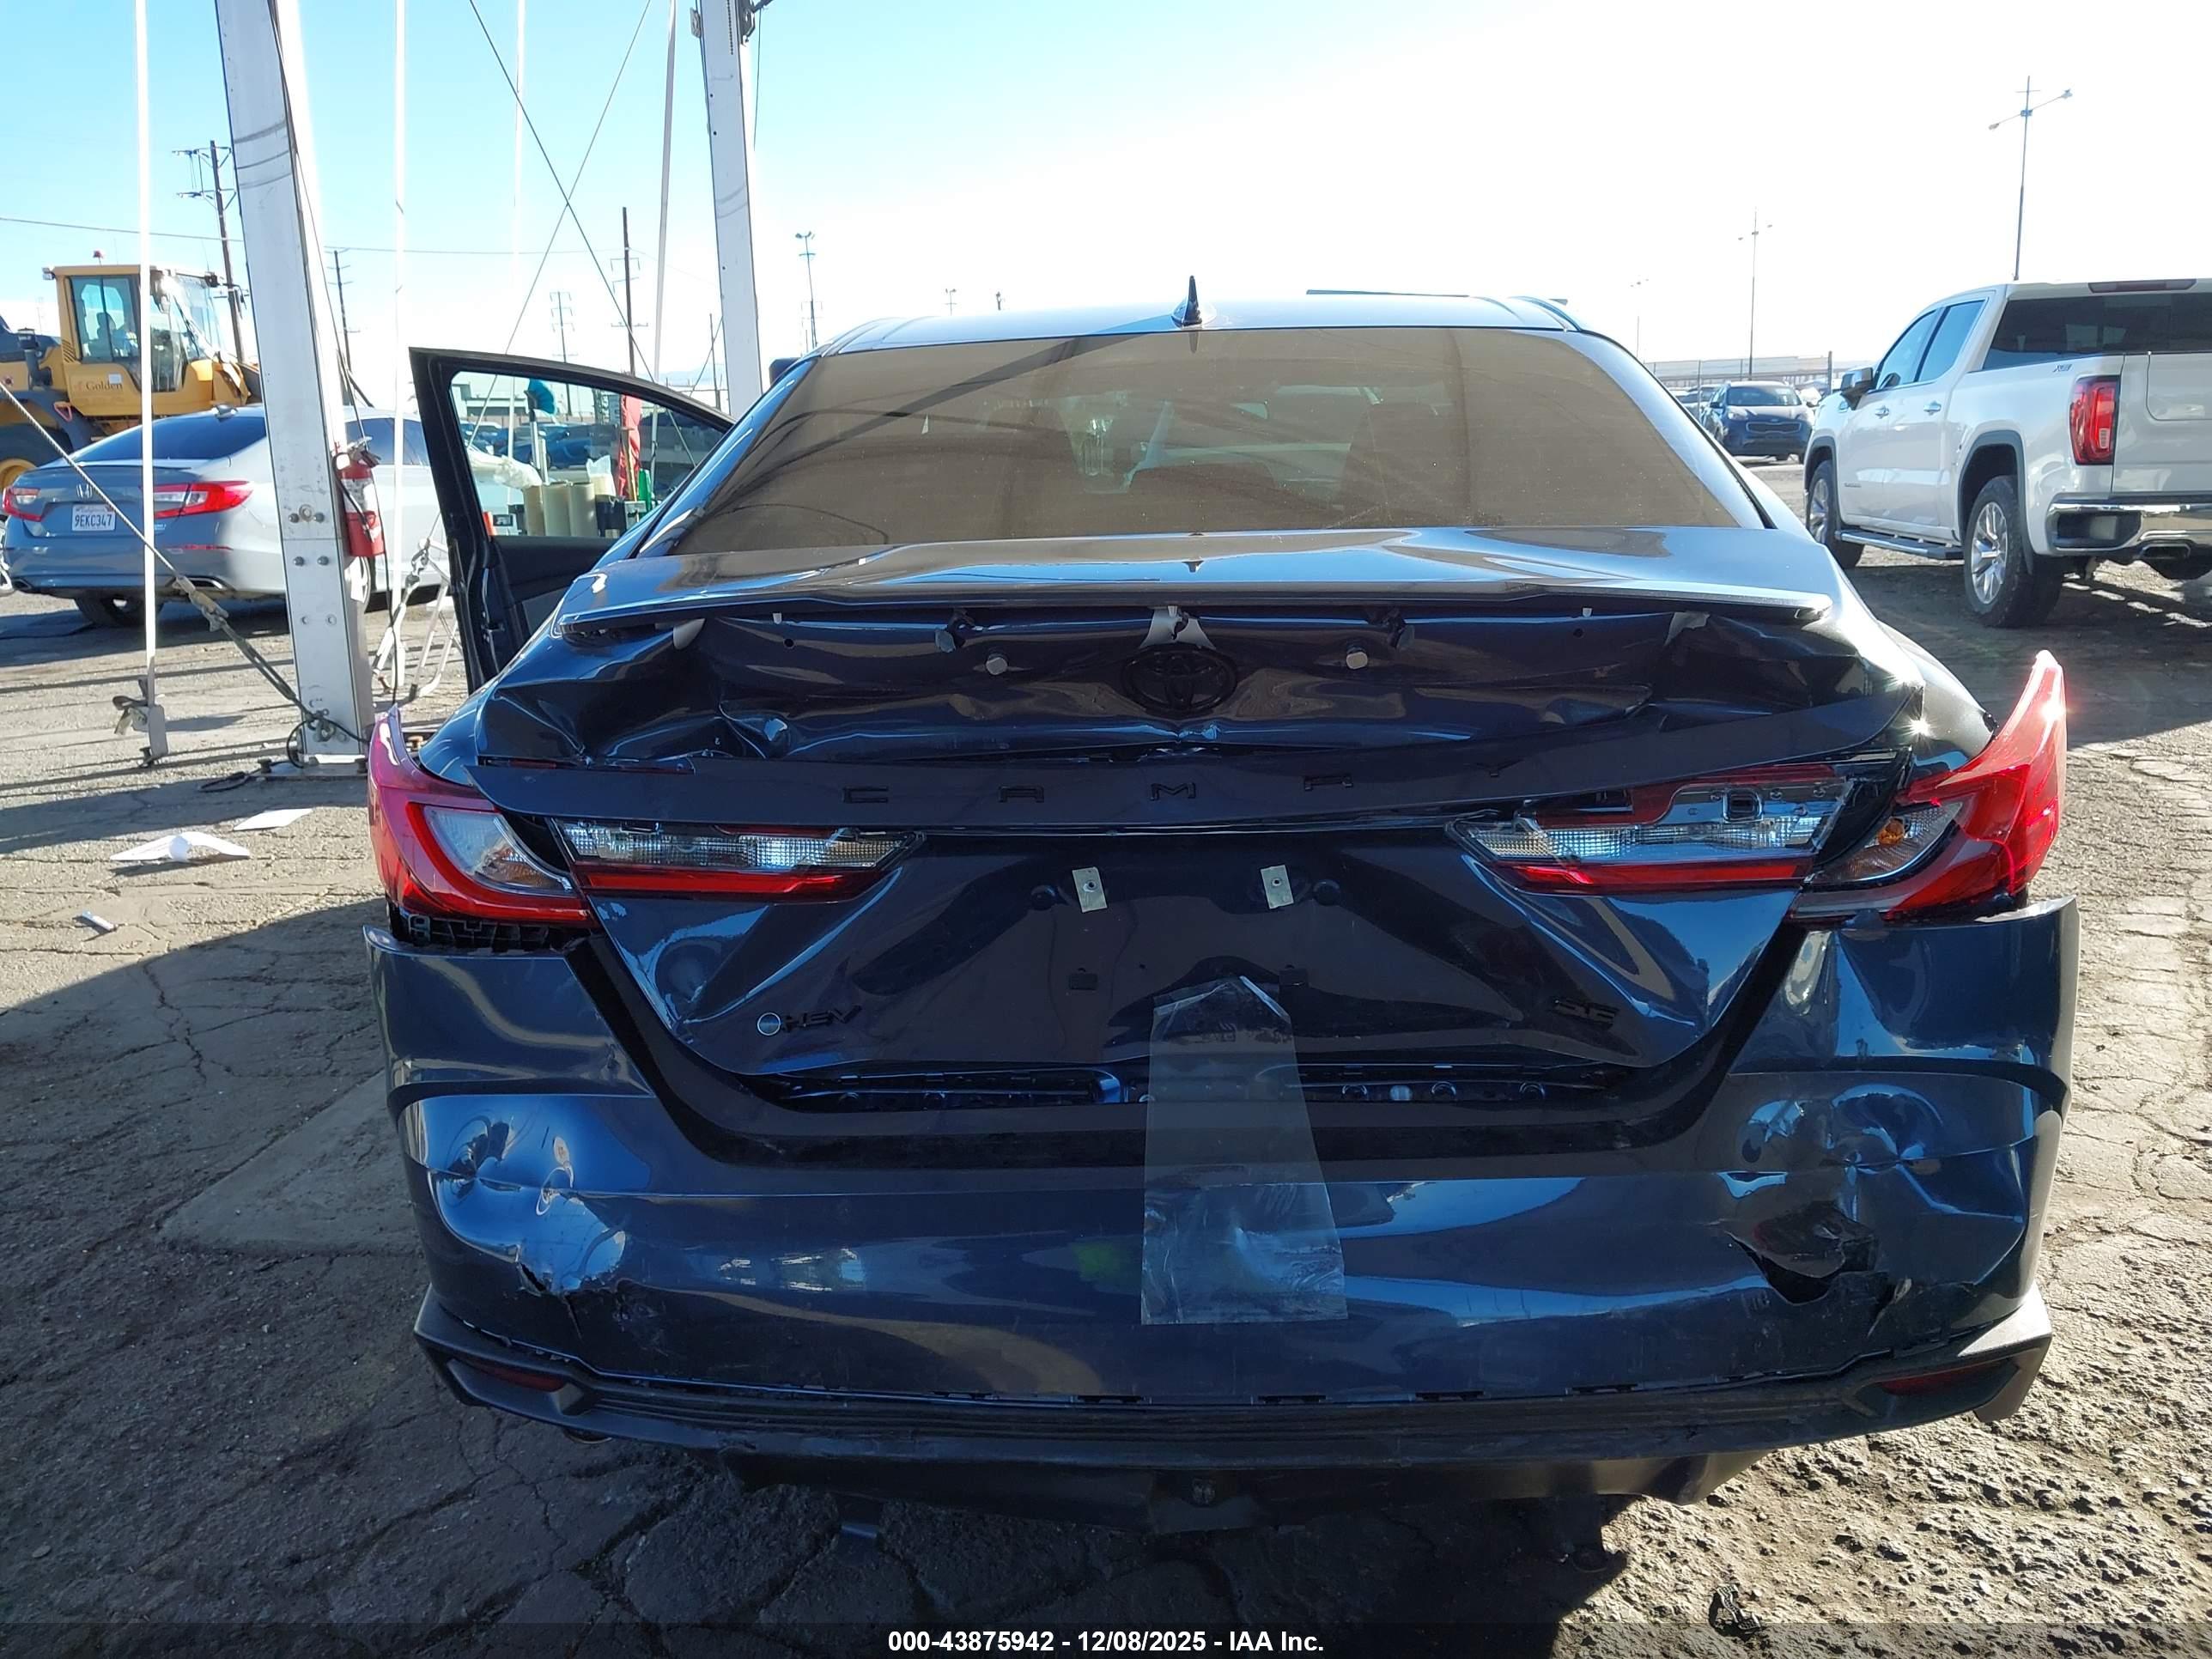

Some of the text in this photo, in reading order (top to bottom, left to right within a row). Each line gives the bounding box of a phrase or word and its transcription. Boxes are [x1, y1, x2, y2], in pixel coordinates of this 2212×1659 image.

[86, 380, 123, 391] Golden
[75, 514, 112, 527] 9EKC347
[842, 757, 1519, 804] CAMRY
